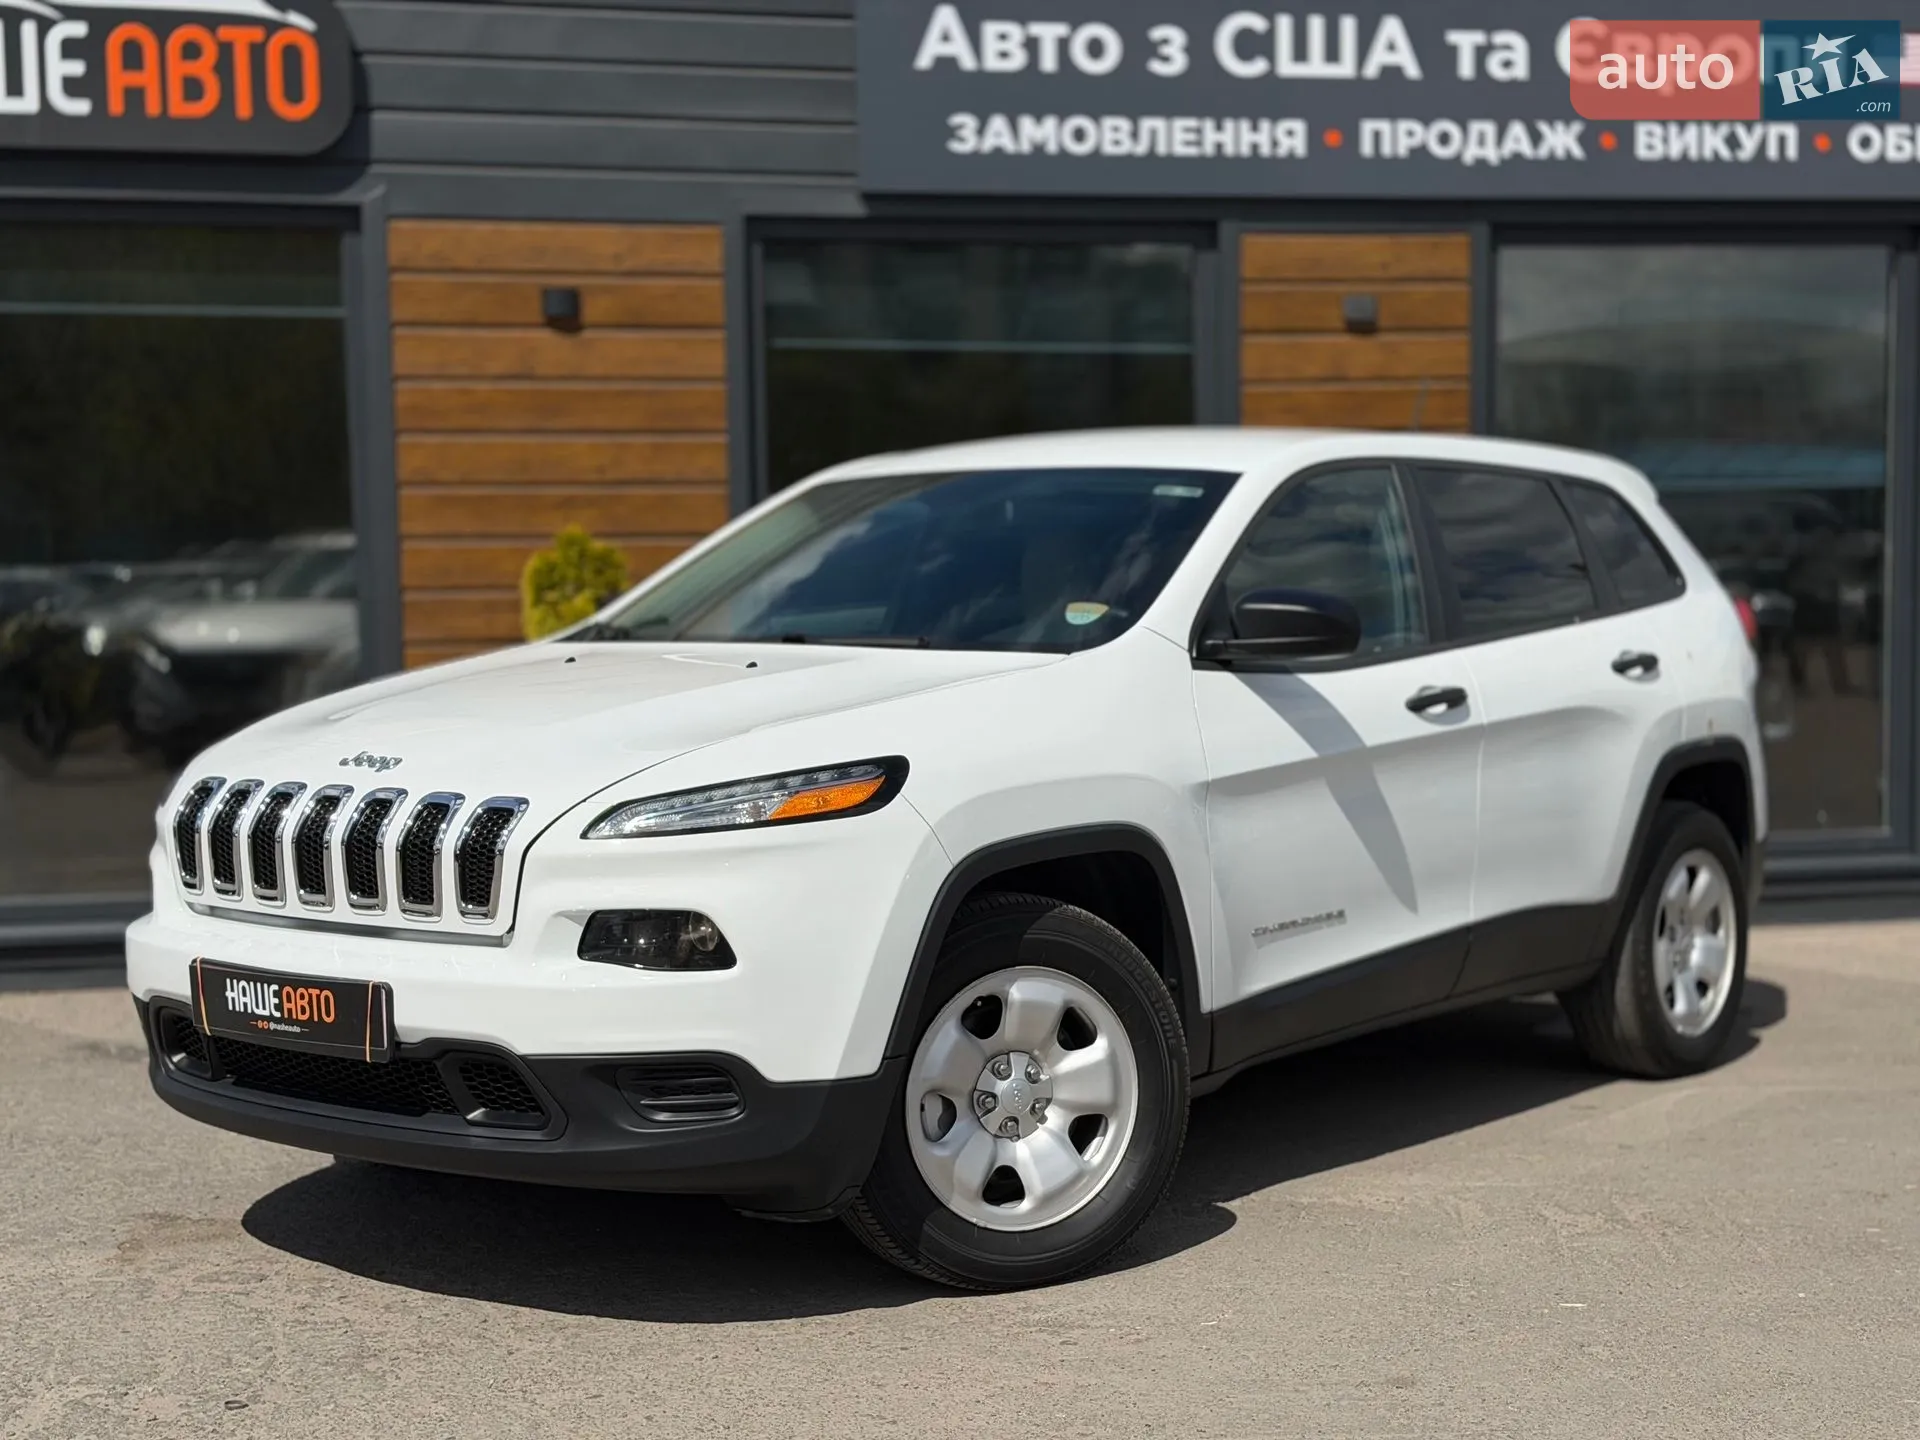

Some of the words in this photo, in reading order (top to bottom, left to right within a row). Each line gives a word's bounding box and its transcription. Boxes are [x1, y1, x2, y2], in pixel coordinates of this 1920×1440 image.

[105, 21, 322, 122] АВТО
[914, 4, 1125, 76] Авто
[1147, 24, 1190, 78] з
[1213, 11, 1424, 81] США
[1445, 29, 1531, 83] та
[947, 112, 1309, 159] ЗАМОВЛЕННЯ
[1359, 118, 1587, 167] ПРОДАЖ
[1634, 121, 1800, 163] ВИКУП
[1846, 122, 1920, 164] ОБ
[225, 977, 282, 1018] НАШЕ
[282, 985, 336, 1024] АВТО
